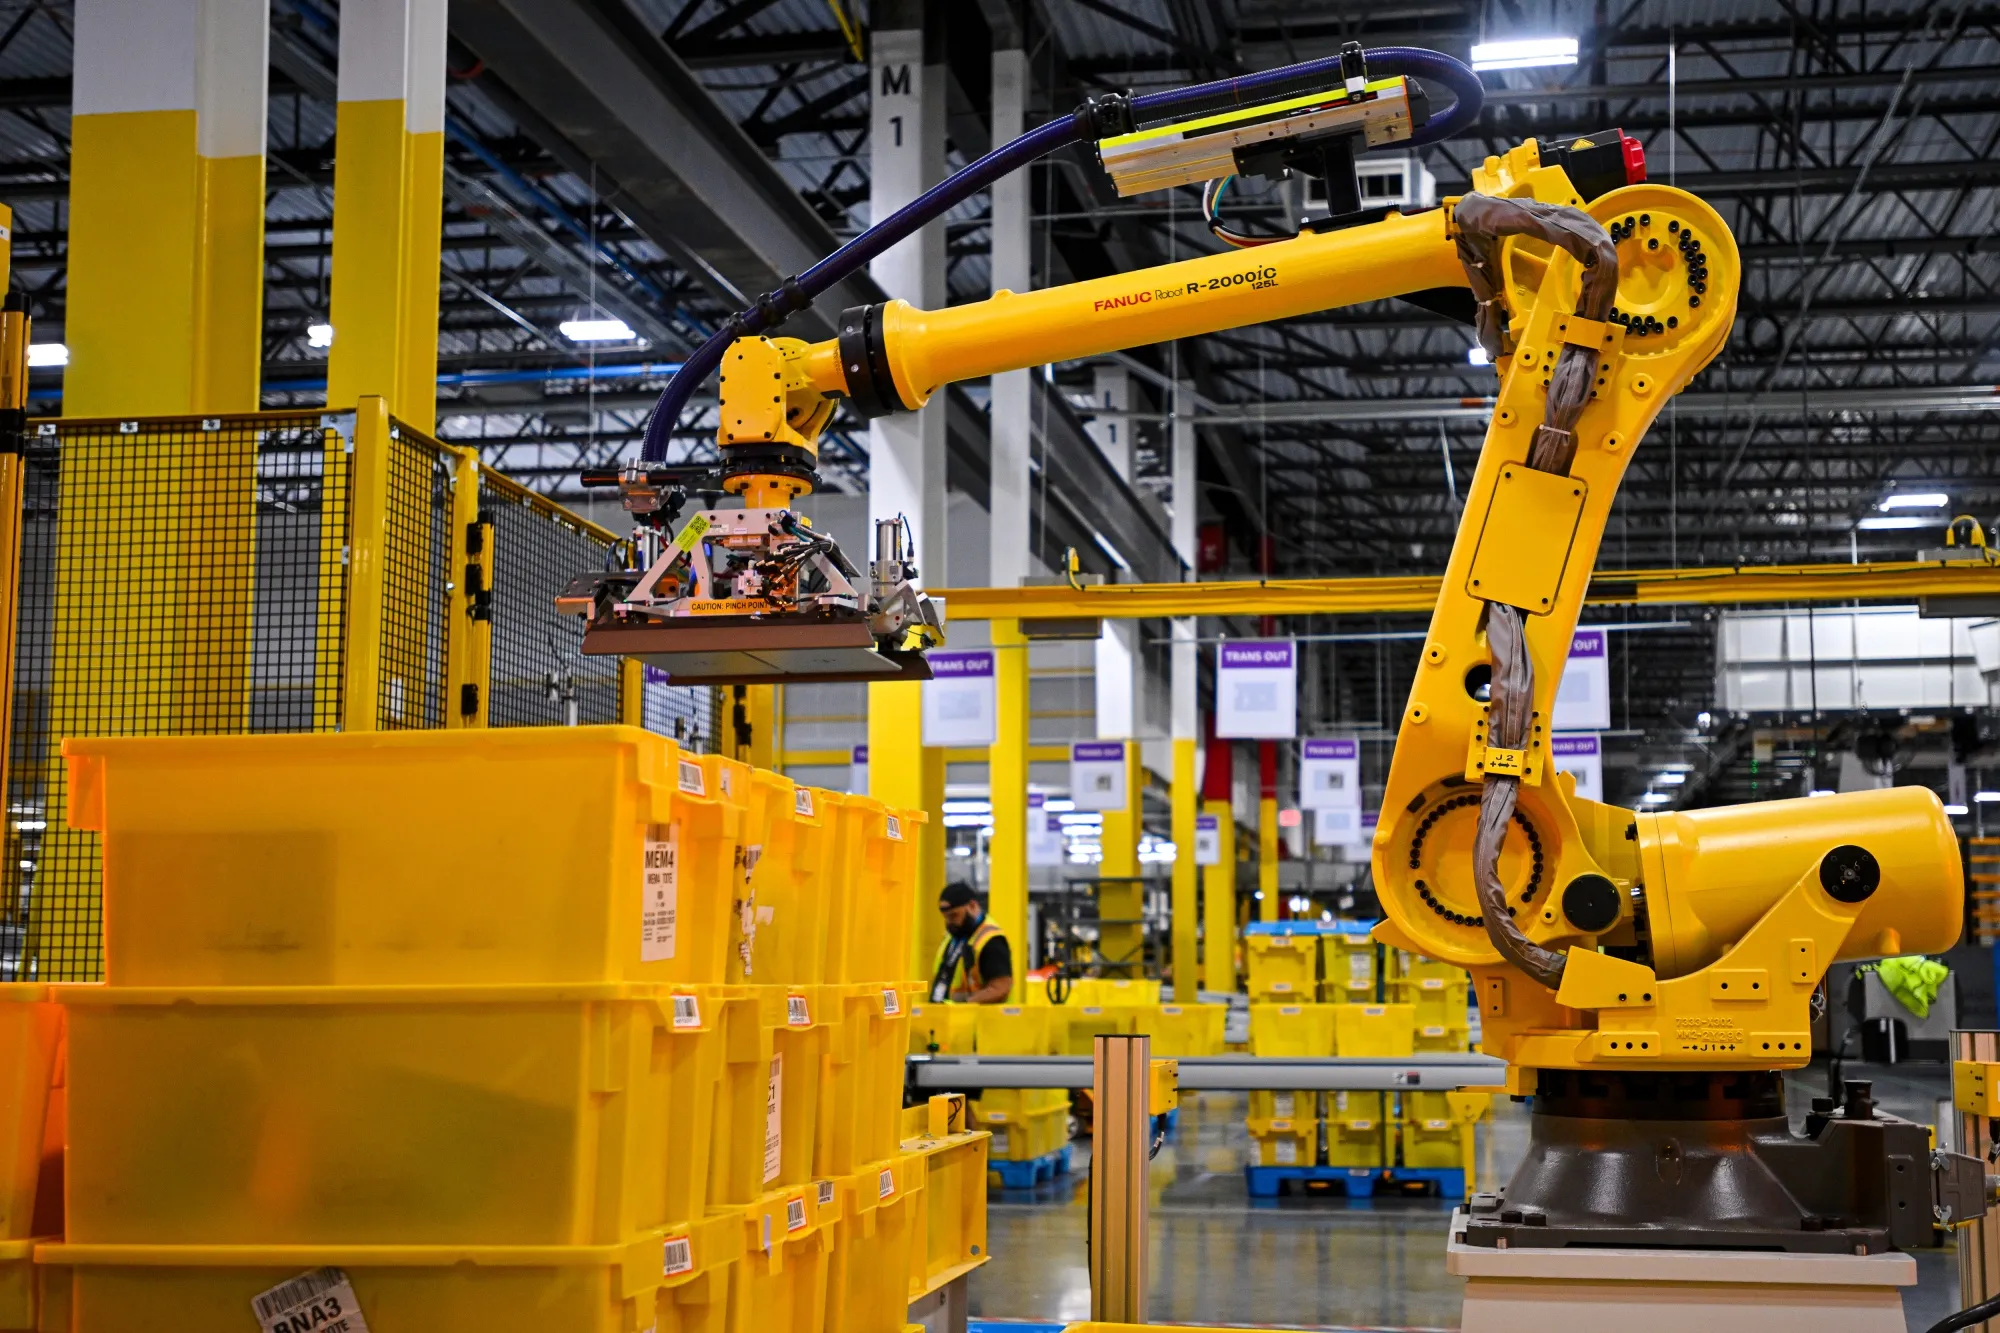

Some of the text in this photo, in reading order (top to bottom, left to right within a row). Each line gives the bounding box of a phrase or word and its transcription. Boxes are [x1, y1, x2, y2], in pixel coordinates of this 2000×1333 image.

[881, 64, 911, 96] M
[889, 116, 903, 147] 1
[1094, 265, 1277, 312] FANUC Robot R-2000iC
[1251, 280, 1279, 290] 125L
[1107, 423, 1116, 444] 1
[691, 602, 723, 611] CAUTION:
[725, 602, 746, 610] PINCH
[1573, 639, 1599, 651] OUT
[1225, 650, 1288, 662] TRANS OUT
[930, 659, 989, 671] TRANS OUT
[1553, 742, 1594, 752] RANS OUT
[645, 850, 674, 869] MEM4
